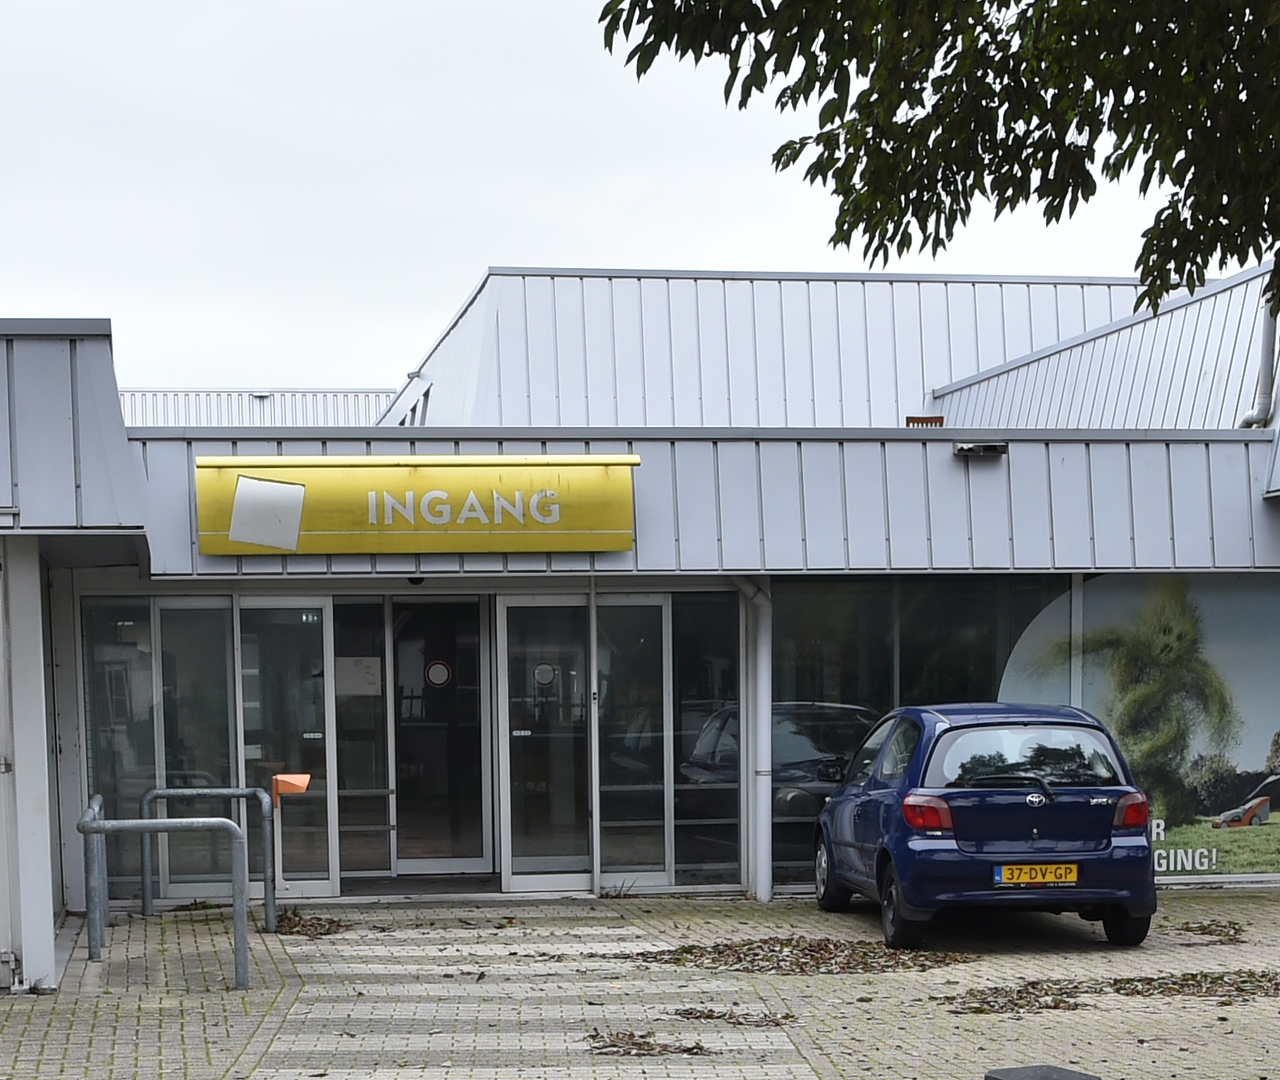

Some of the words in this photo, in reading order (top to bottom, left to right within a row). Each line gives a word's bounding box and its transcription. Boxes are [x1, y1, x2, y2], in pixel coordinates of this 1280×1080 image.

[367, 490, 561, 525] INGANG
[1151, 819, 1166, 841] R
[1153, 848, 1218, 872] GING!
[1006, 867, 1073, 881] 37-DV-GP
